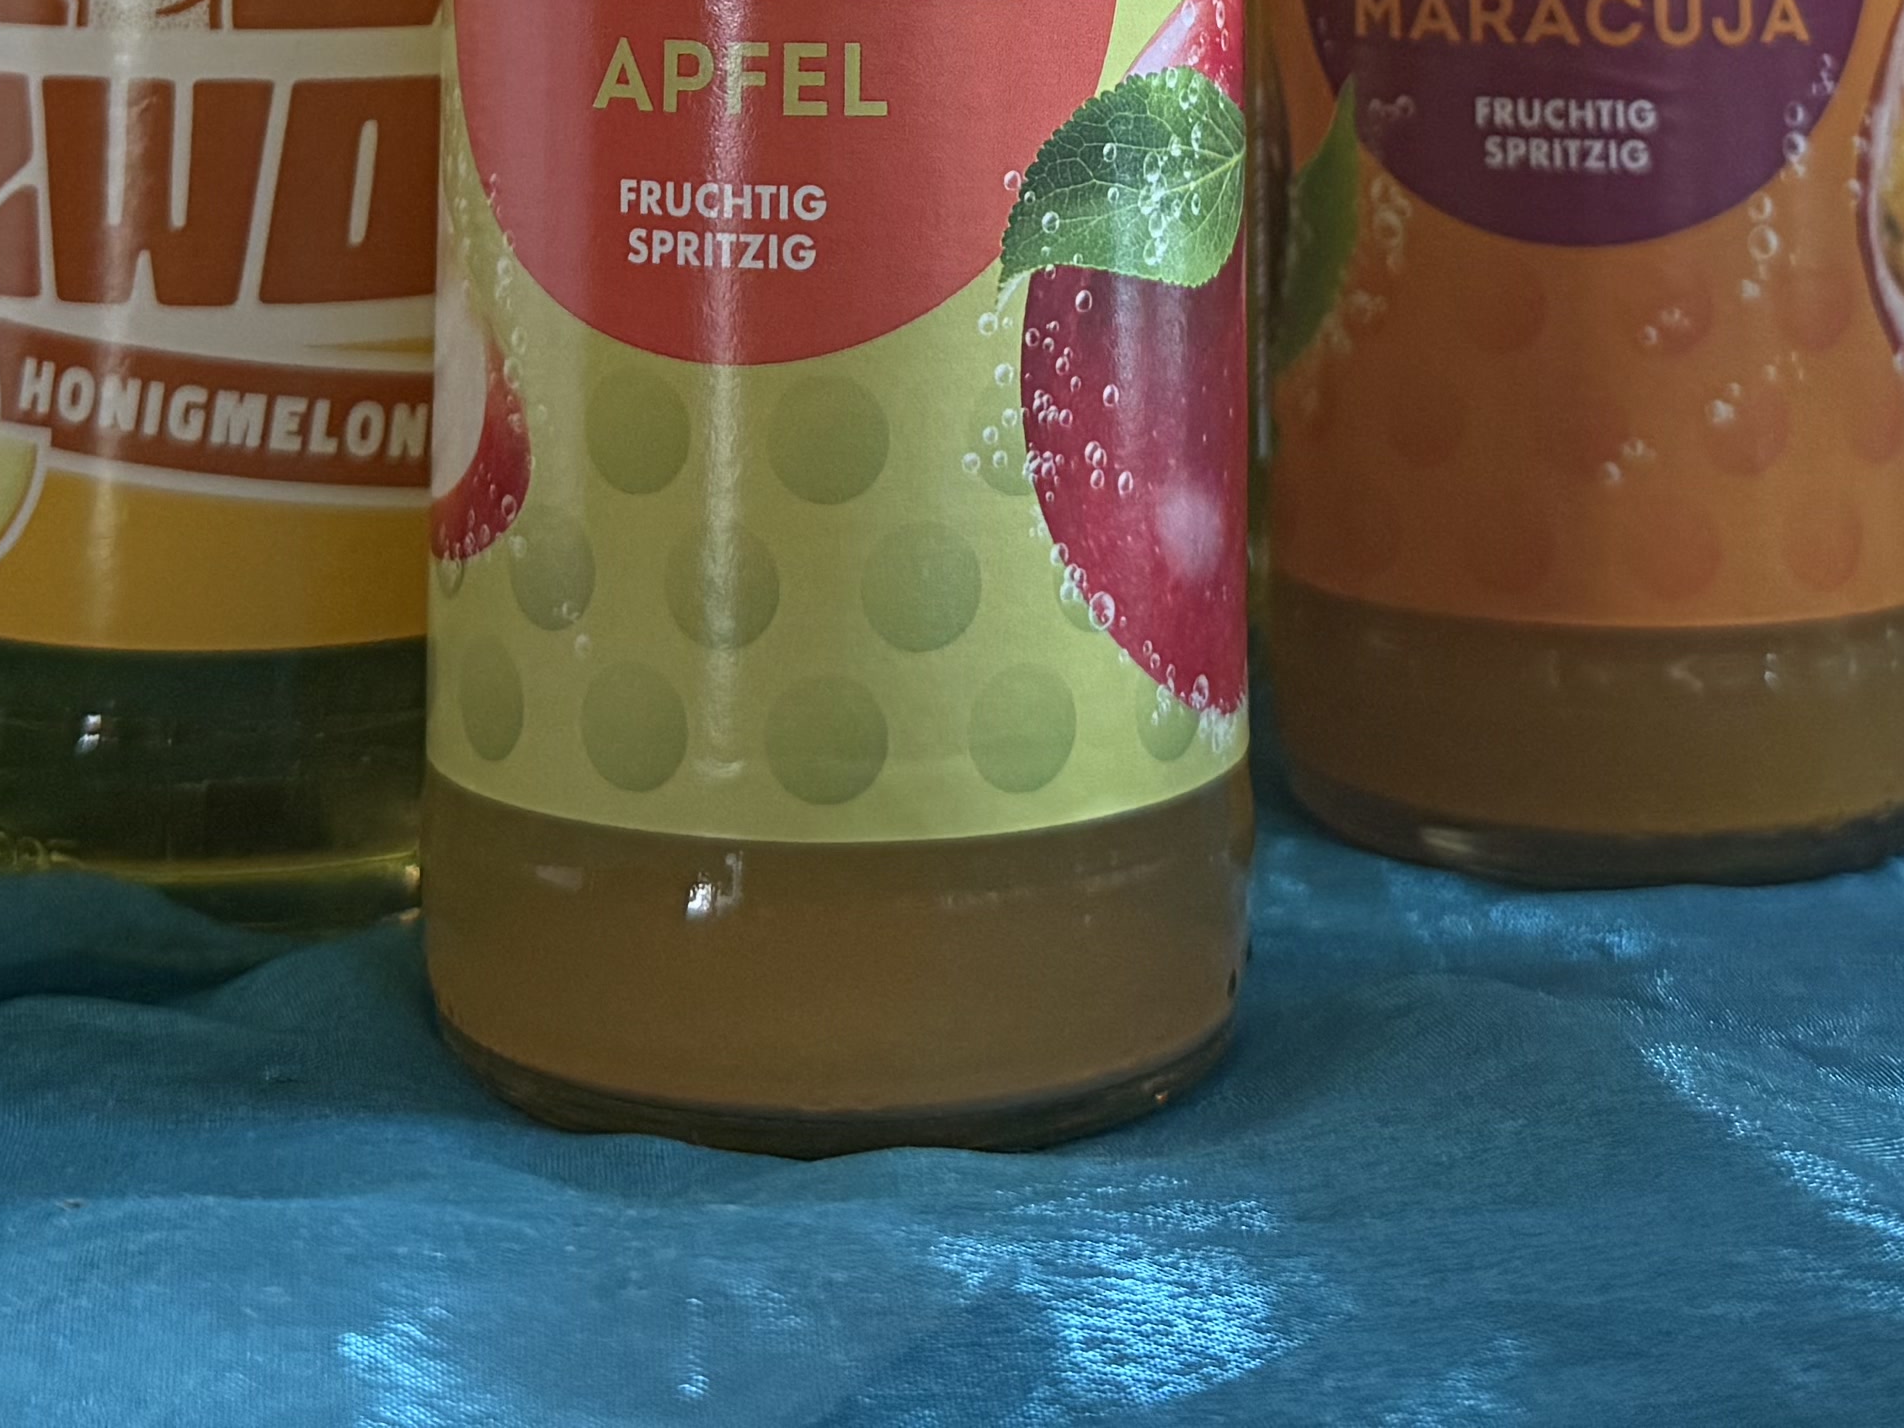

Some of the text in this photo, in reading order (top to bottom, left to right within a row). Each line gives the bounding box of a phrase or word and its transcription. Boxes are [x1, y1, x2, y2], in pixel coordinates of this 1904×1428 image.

[592, 37, 889, 118] APFEL
[1474, 96, 1658, 132] FRUCHTIG
[1483, 135, 1650, 171] SPRITZIG
[618, 178, 828, 222] FRUCHTIG
[626, 226, 817, 272] SPRITZIG
